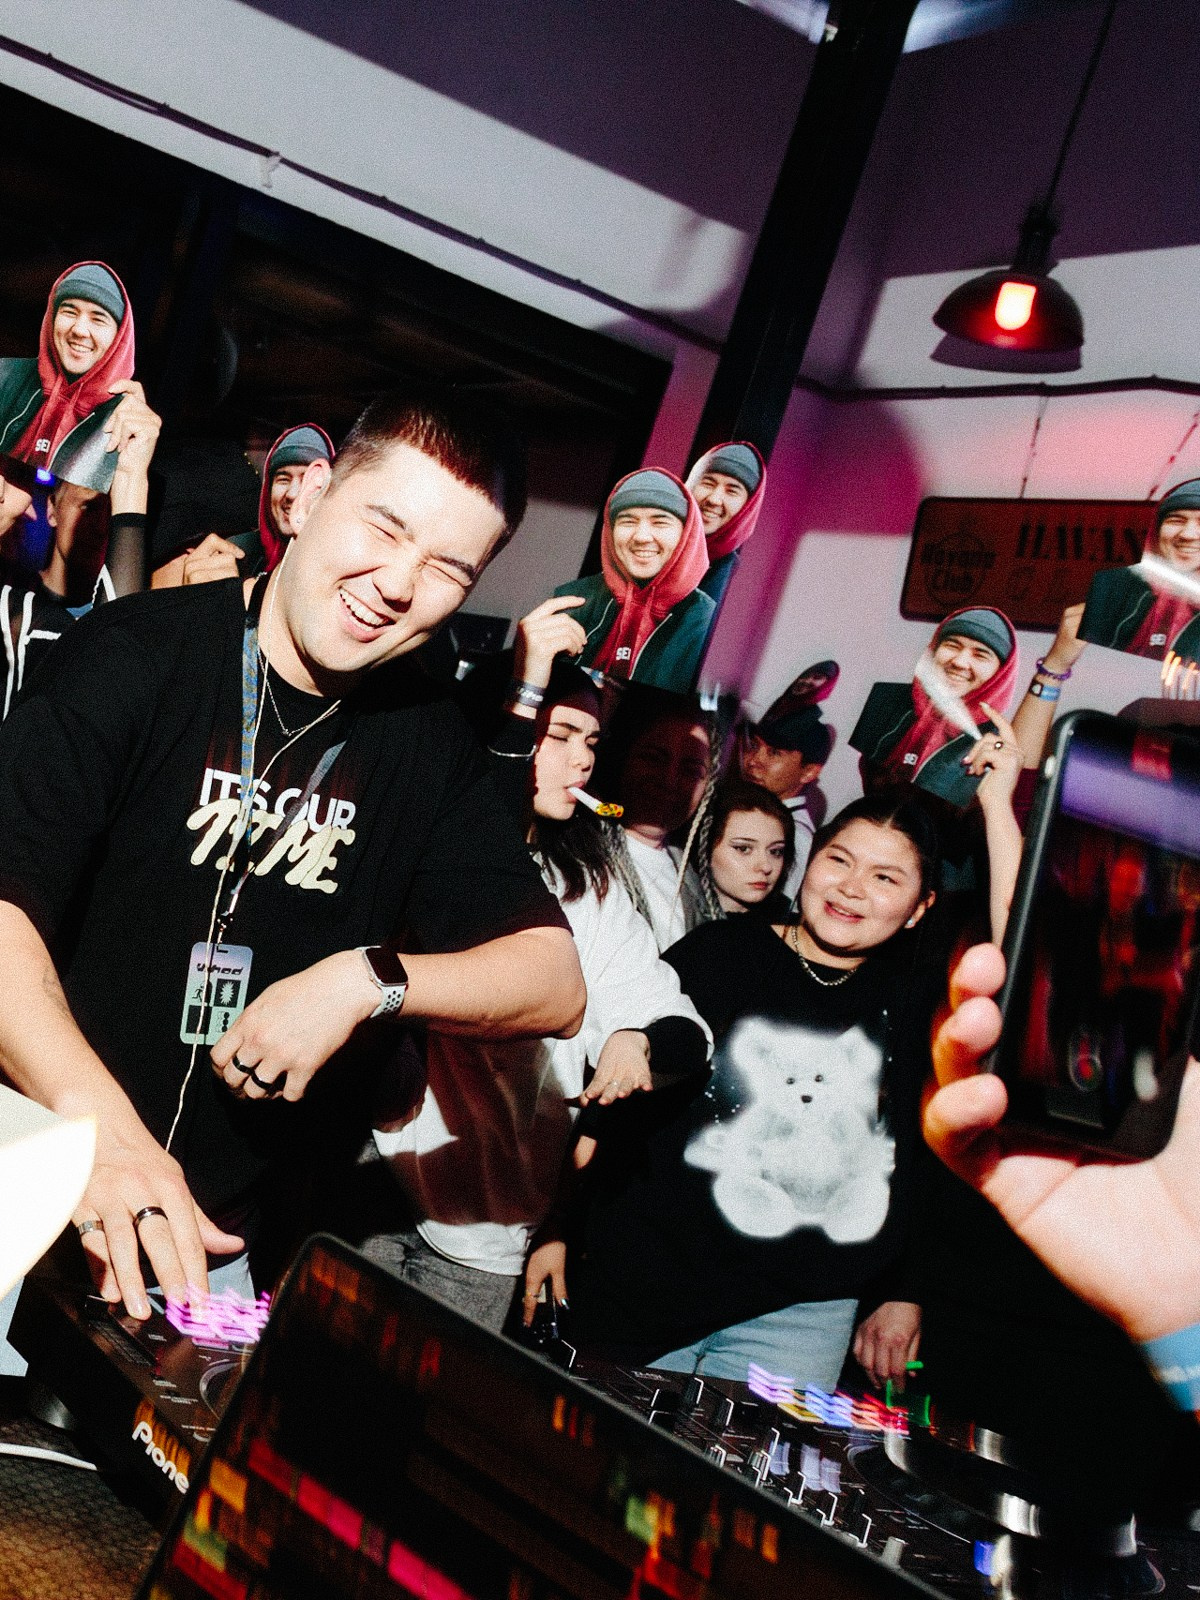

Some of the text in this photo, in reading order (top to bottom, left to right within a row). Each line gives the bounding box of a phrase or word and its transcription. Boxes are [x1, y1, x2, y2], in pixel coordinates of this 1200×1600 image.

[199, 767, 356, 833] ITS OUR
[131, 1420, 190, 1495] Pione
